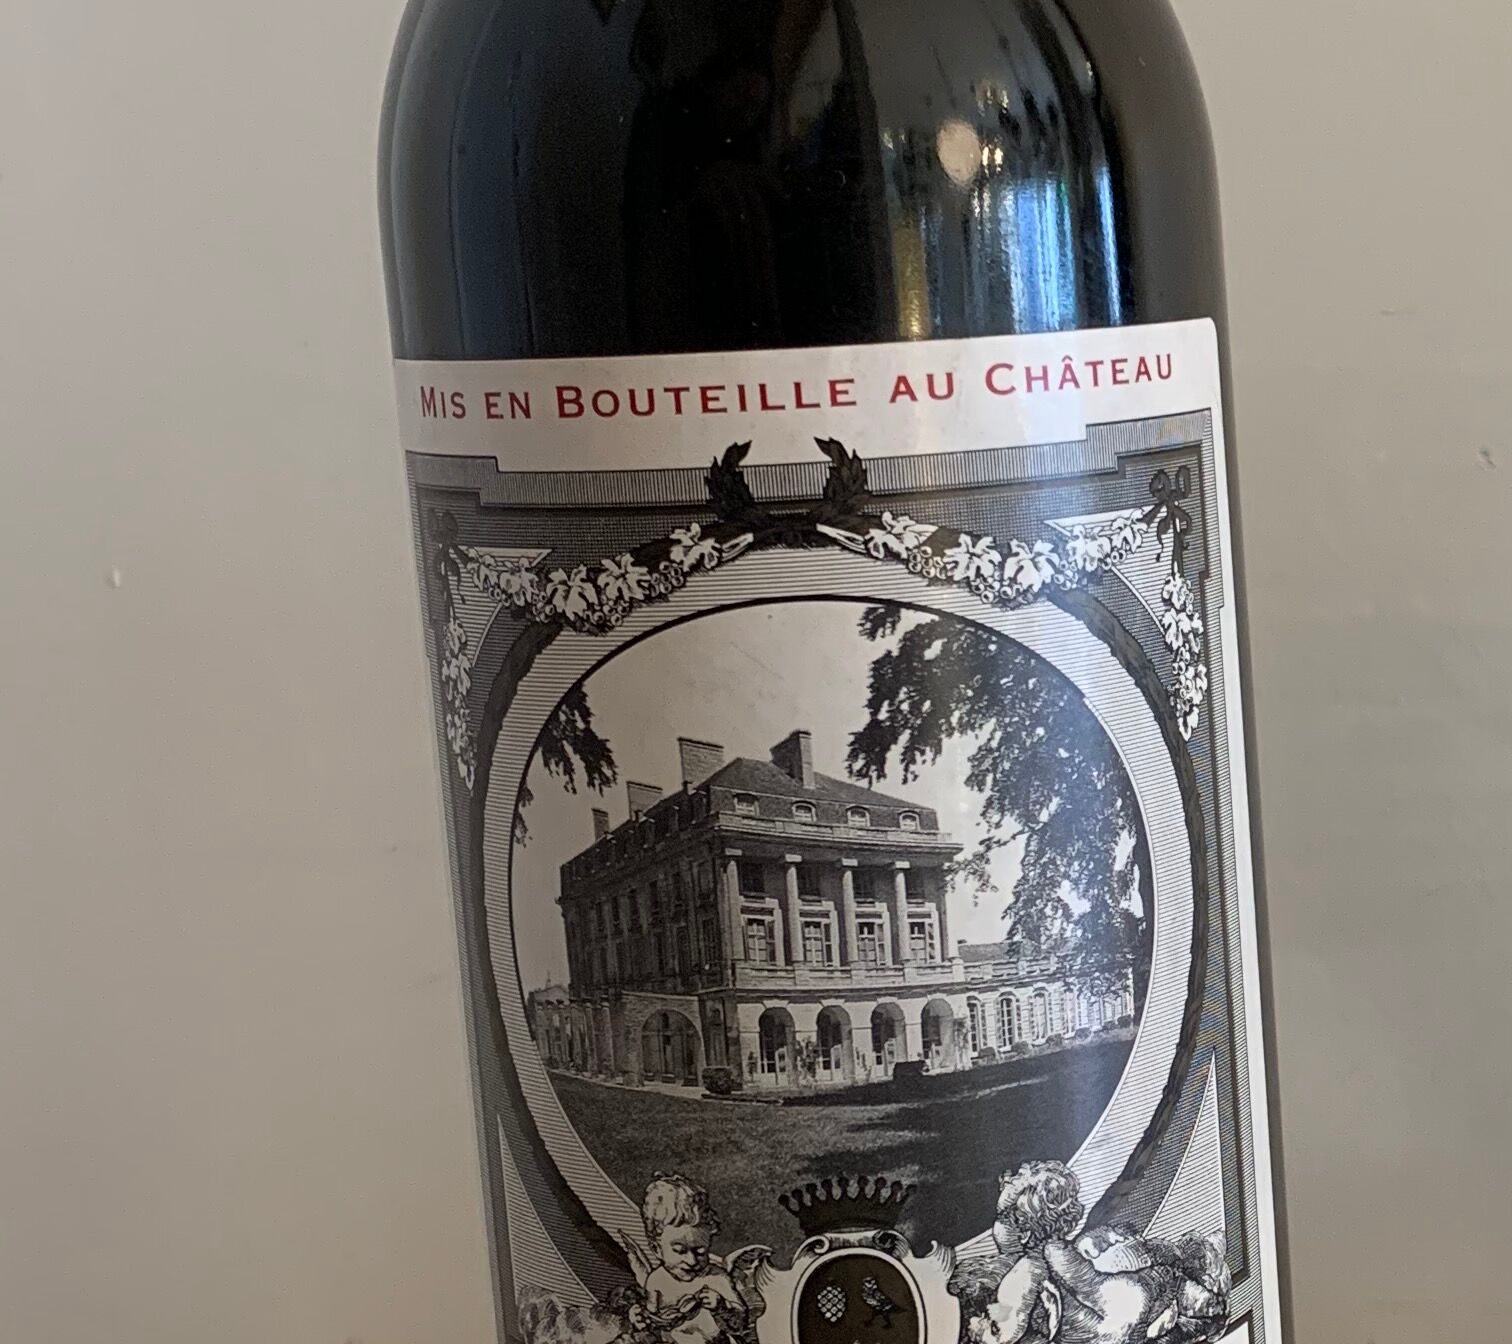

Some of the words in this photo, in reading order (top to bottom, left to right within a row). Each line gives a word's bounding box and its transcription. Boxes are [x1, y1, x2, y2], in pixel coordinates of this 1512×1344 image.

[484, 391, 532, 420] EN
[556, 378, 857, 420] BOUTEILLE
[889, 371, 955, 404] AU
[985, 353, 1174, 397] CHÂTEAU
